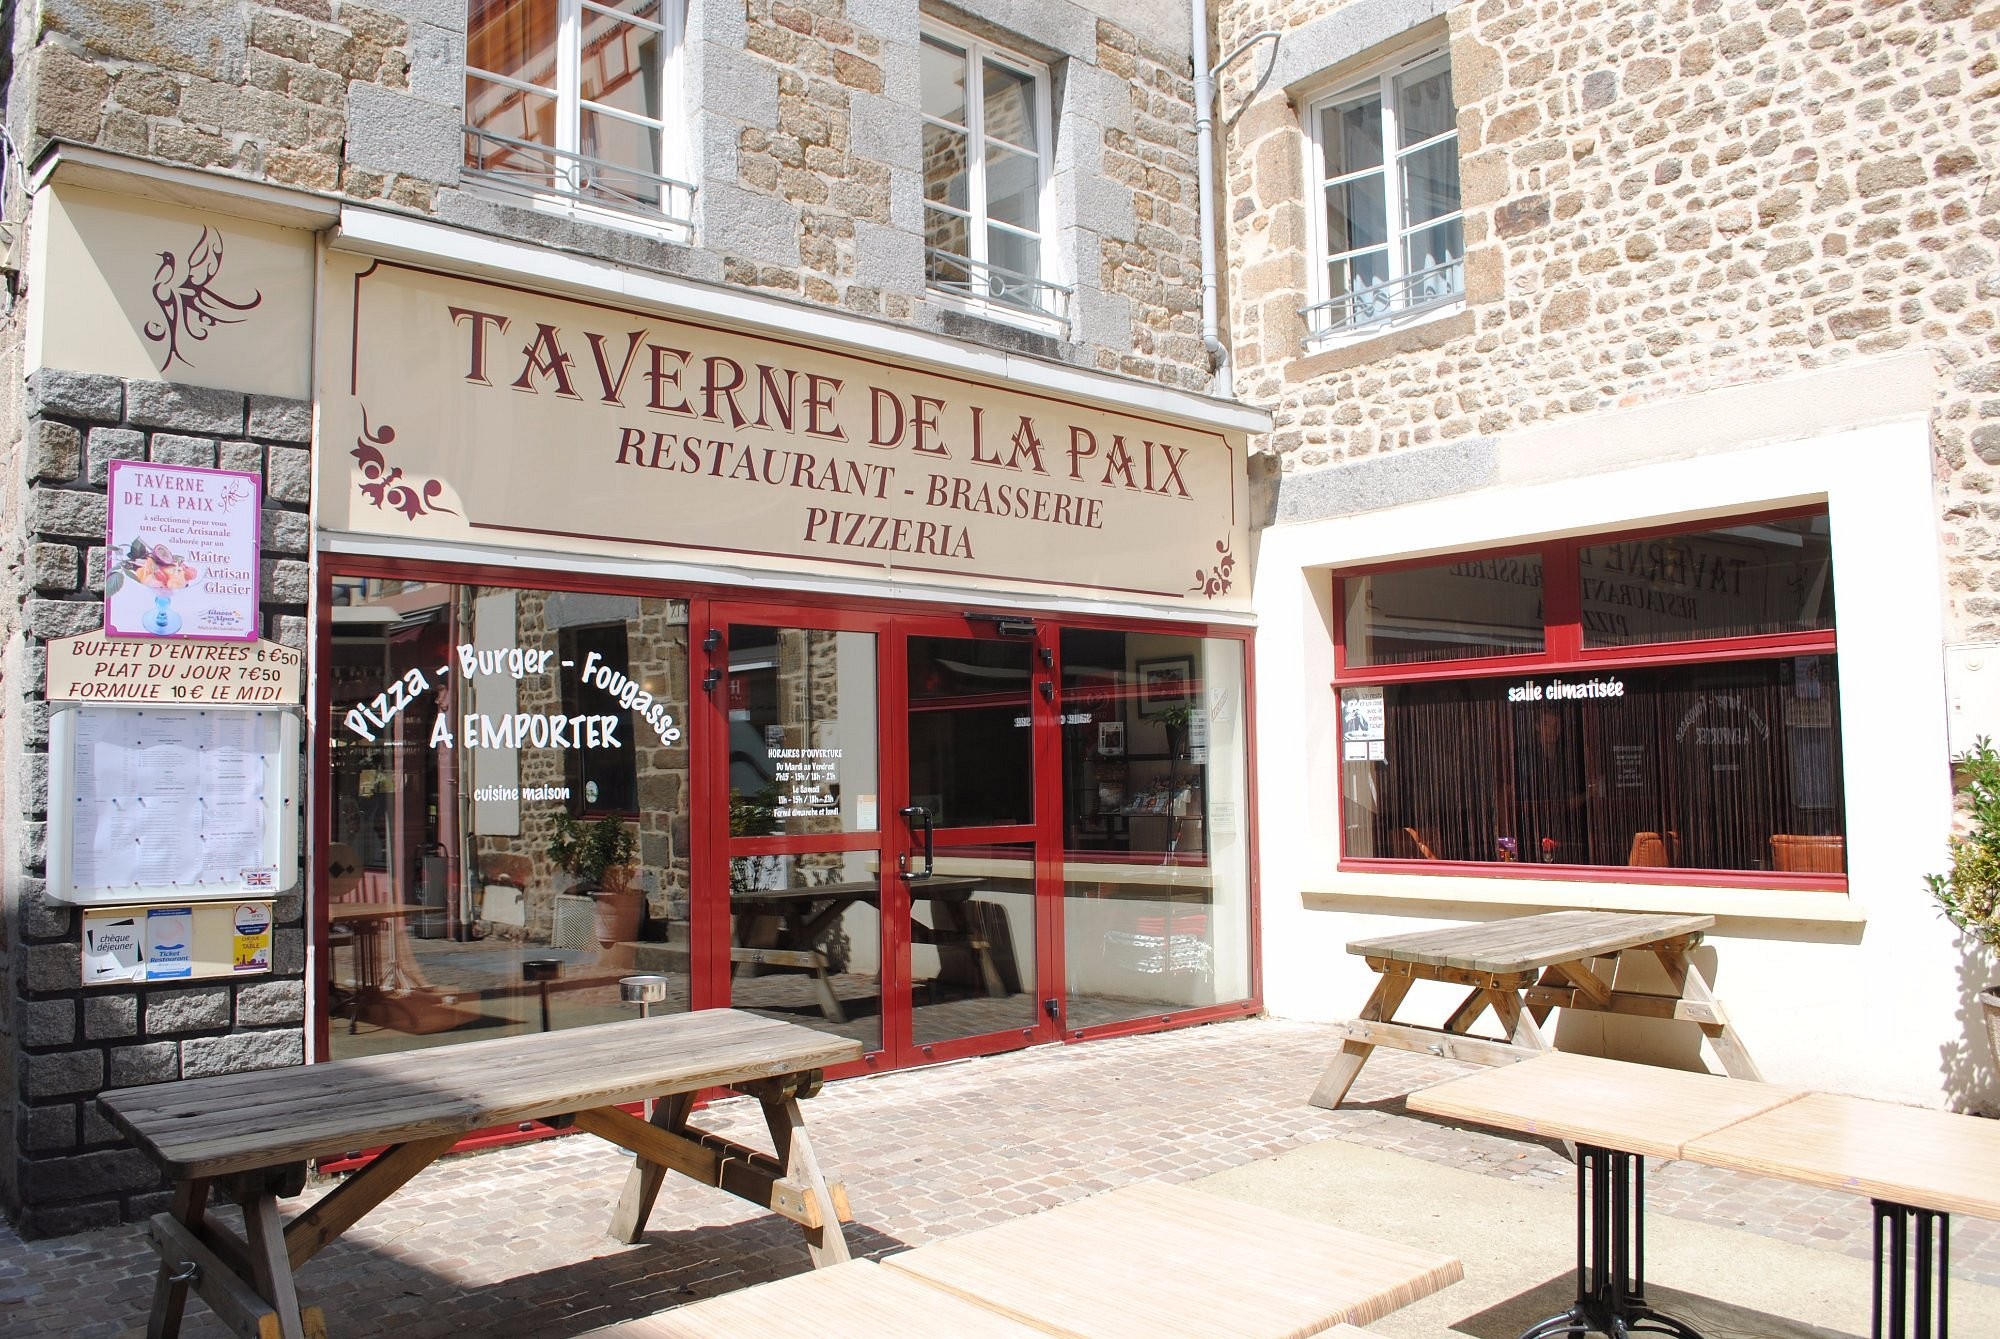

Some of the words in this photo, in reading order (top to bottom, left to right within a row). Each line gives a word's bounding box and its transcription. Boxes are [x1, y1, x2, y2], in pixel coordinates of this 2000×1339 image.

[448, 305, 849, 443] TAVERNE
[868, 386, 952, 460] DE
[970, 406, 1050, 477] LA
[1066, 425, 1193, 501] PAIX
[135, 473, 204, 492] TAVERNE
[615, 427, 895, 500] RESTAURANT
[926, 474, 1104, 529] BRASSERIE
[124, 491, 143, 506] DE
[151, 493, 169, 508] LA
[178, 495, 214, 511] PAIX
[150, 515, 190, 524] sélectionné
[192, 518, 209, 527] pour
[159, 524, 184, 534] Glace
[186, 526, 231, 537] Artisanale
[803, 507, 975, 559] PIZZERIA
[168, 536, 198, 546] élaborée
[200, 540, 213, 548] par
[188, 550, 231, 563] Maître
[206, 566, 250, 580] Artisan
[205, 582, 251, 594] Glacier
[72, 641, 143, 657] BUFFET
[149, 643, 250, 661] D'ENTRÉES
[94, 662, 142, 678] PLAT
[148, 664, 175, 679] DU
[181, 666, 231, 681] JOUR
[239, 667, 281, 682] 7€50
[69, 683, 161, 699] FORMULE
[211, 685, 230, 699] LE
[236, 686, 282, 700] MIDI
[344, 667, 430, 742] Pizza
[456, 643, 553, 680] Burger
[581, 651, 681, 746] Fougasse
[1508, 680, 1542, 702] salle
[1545, 675, 1624, 700] climatisée
[430, 712, 453, 749] A
[463, 714, 621, 749] EMPORTER
[768, 748, 800, 759] HORAIRES
[801, 748, 842, 758] D'OUVERTURE
[776, 763, 784, 771] Du
[784, 762, 803, 771] Mardi
[811, 762, 835, 771] Vendredi
[474, 784, 519, 801] cuisine
[522, 784, 570, 800] maison
[792, 785, 799, 794] Le
[800, 785, 820, 794] Samedi
[792, 808, 818, 817] dimanche
[819, 808, 825, 816] et
[825, 807, 839, 816] lundi
[97, 941, 133, 952] déjeuner
[100, 934, 130, 945] chèque
